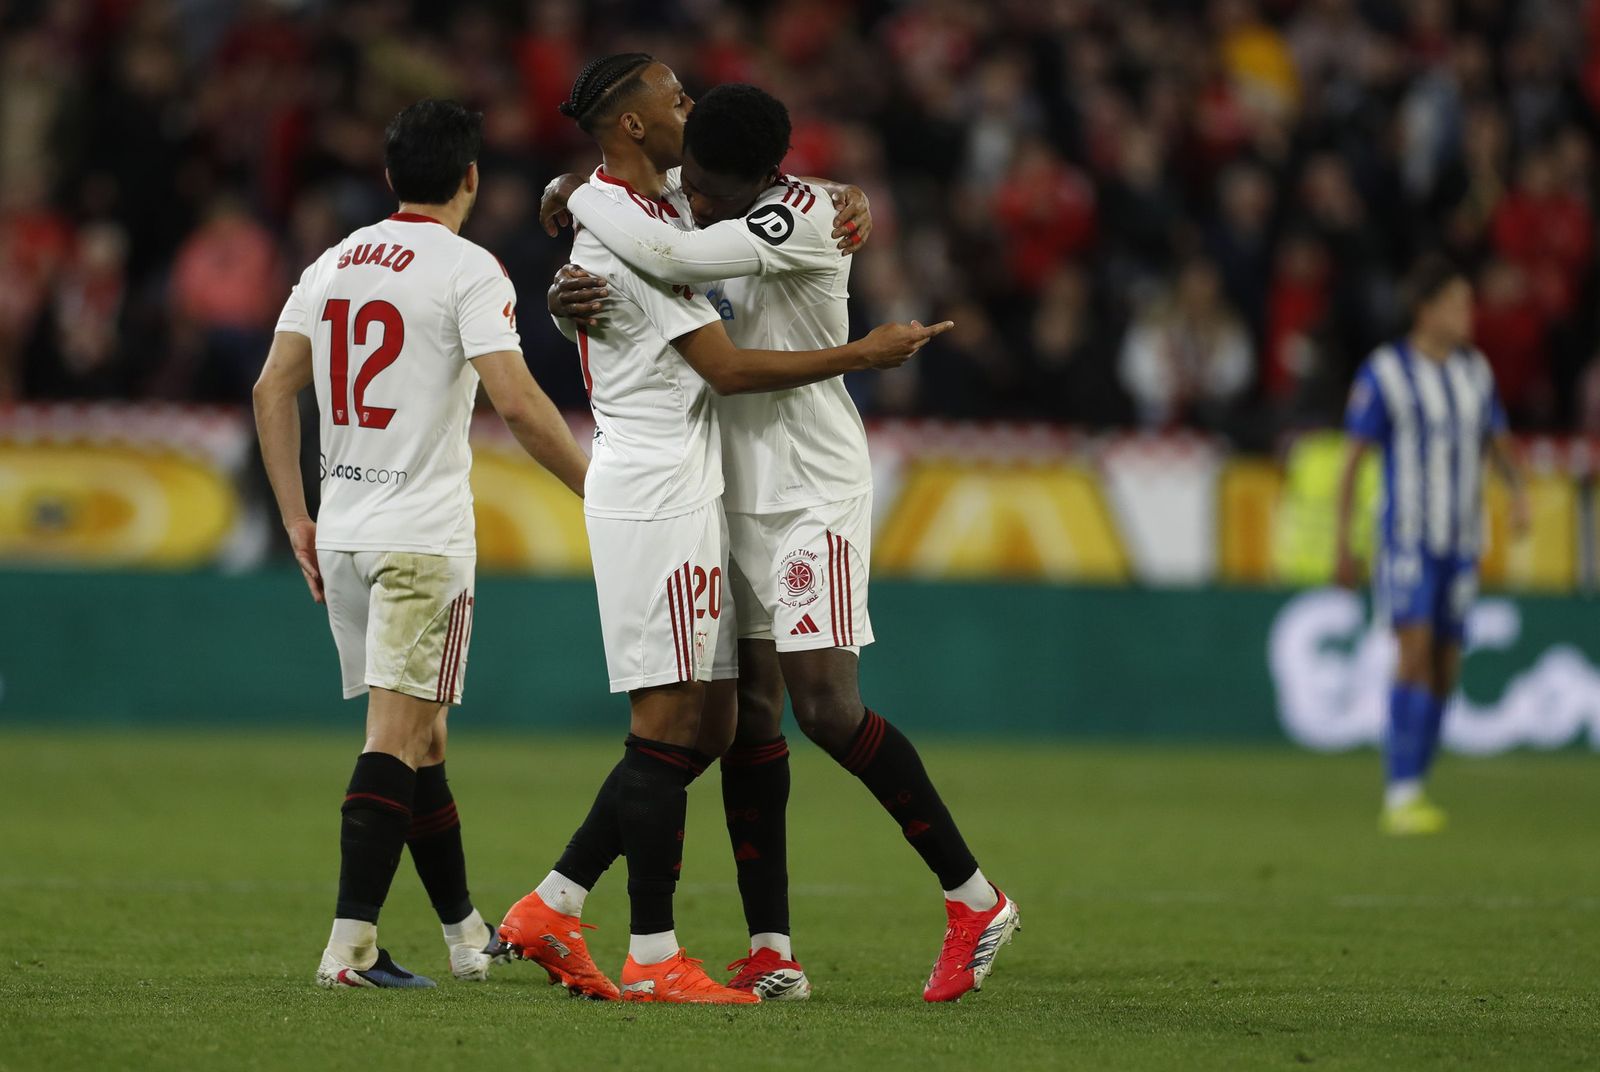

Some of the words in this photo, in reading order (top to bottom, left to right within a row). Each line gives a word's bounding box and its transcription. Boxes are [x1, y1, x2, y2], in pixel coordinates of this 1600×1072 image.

[748, 210, 789, 239] JD
[337, 242, 416, 273] SUAZO
[321, 298, 405, 430] 12
[798, 548, 819, 562] TIME
[693, 565, 722, 620] 20
